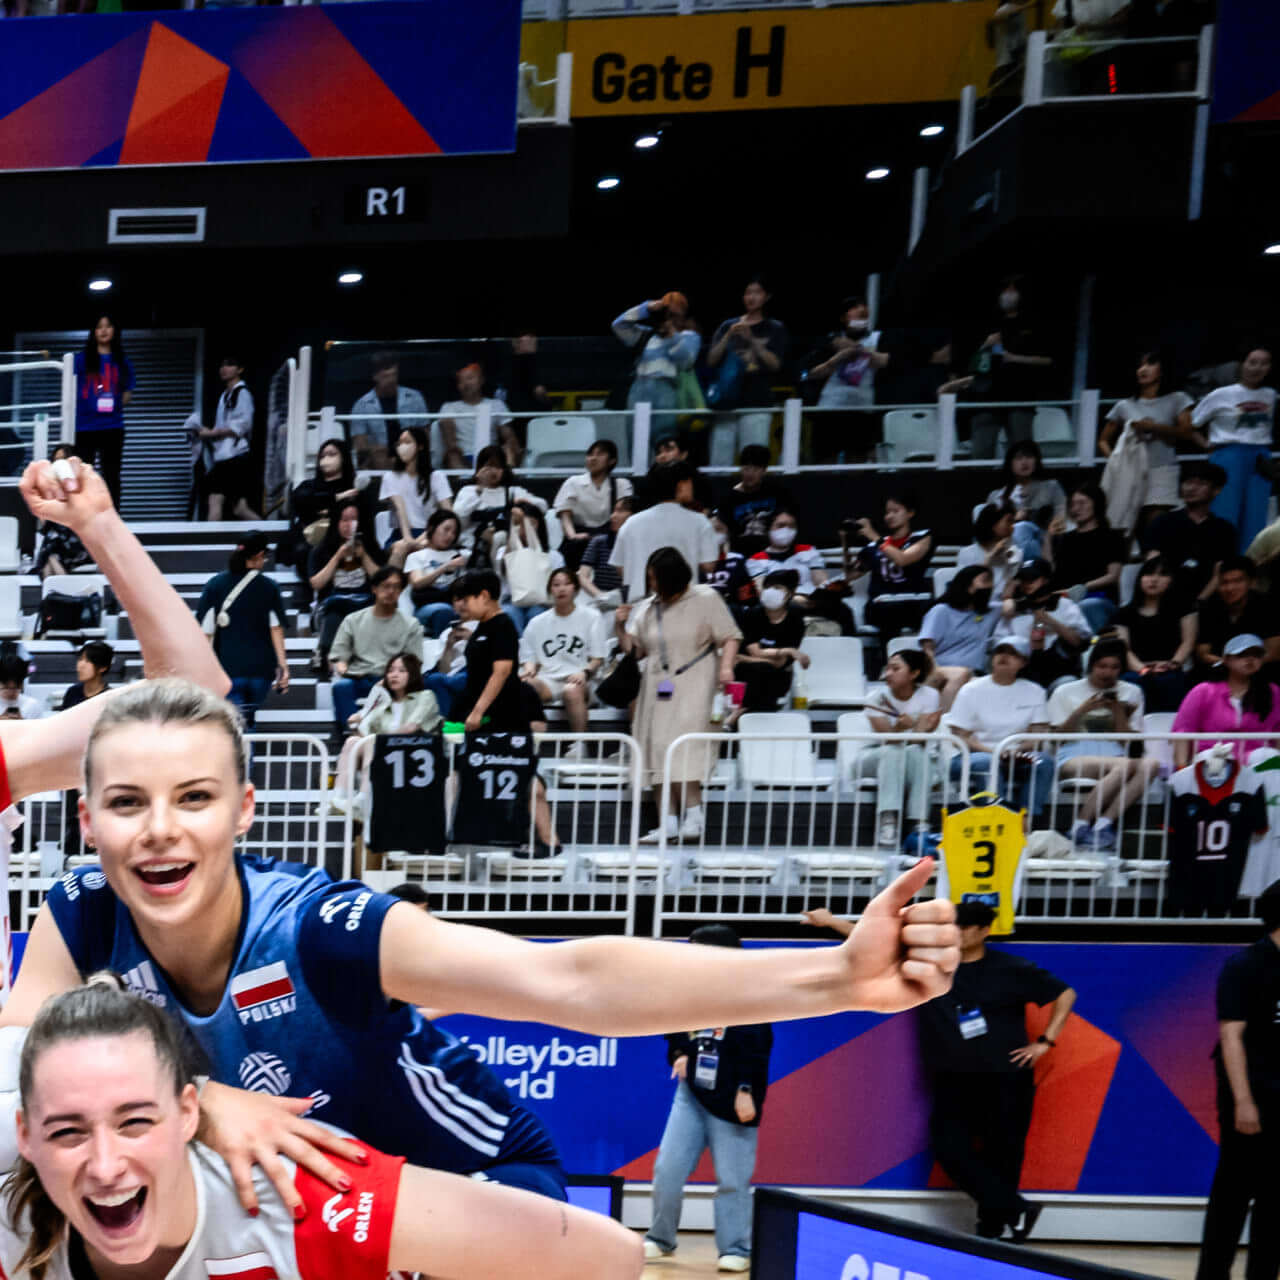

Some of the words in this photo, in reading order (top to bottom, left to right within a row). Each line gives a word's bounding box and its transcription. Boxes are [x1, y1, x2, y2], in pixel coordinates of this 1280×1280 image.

[592, 51, 713, 104] Gate
[733, 24, 787, 99] H
[365, 186, 406, 217] R1
[383, 748, 436, 789] 13
[477, 769, 519, 800] 12
[1196, 819, 1232, 853] 10
[971, 839, 997, 879] 3
[464, 1038, 618, 1075] olleyball
[504, 1072, 556, 1100] rld
[352, 1191, 374, 1243] ORLEN
